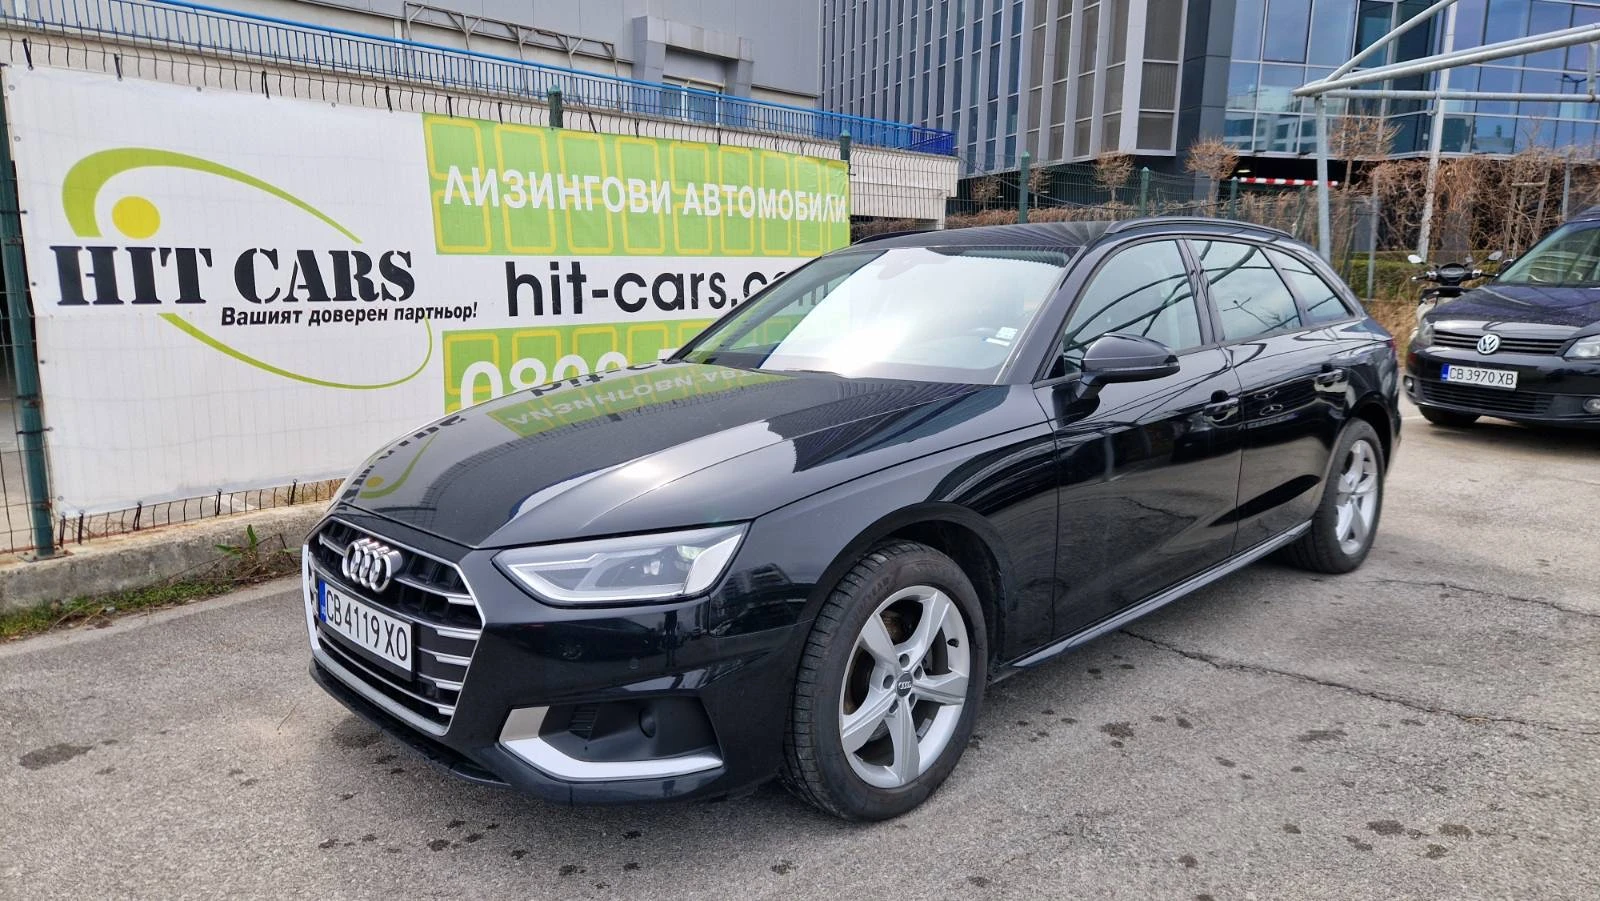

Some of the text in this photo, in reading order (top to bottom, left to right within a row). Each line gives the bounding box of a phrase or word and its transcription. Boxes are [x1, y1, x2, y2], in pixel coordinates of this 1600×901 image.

[443, 165, 846, 224] ЛИЗИНГОВИ АВТОМОБИЛИ
[50, 245, 415, 306] HIT CARS
[221, 301, 478, 327] Вашият доверен партньор!
[1450, 367, 1514, 386] CB 3970 XB
[344, 601, 380, 648] 4119
